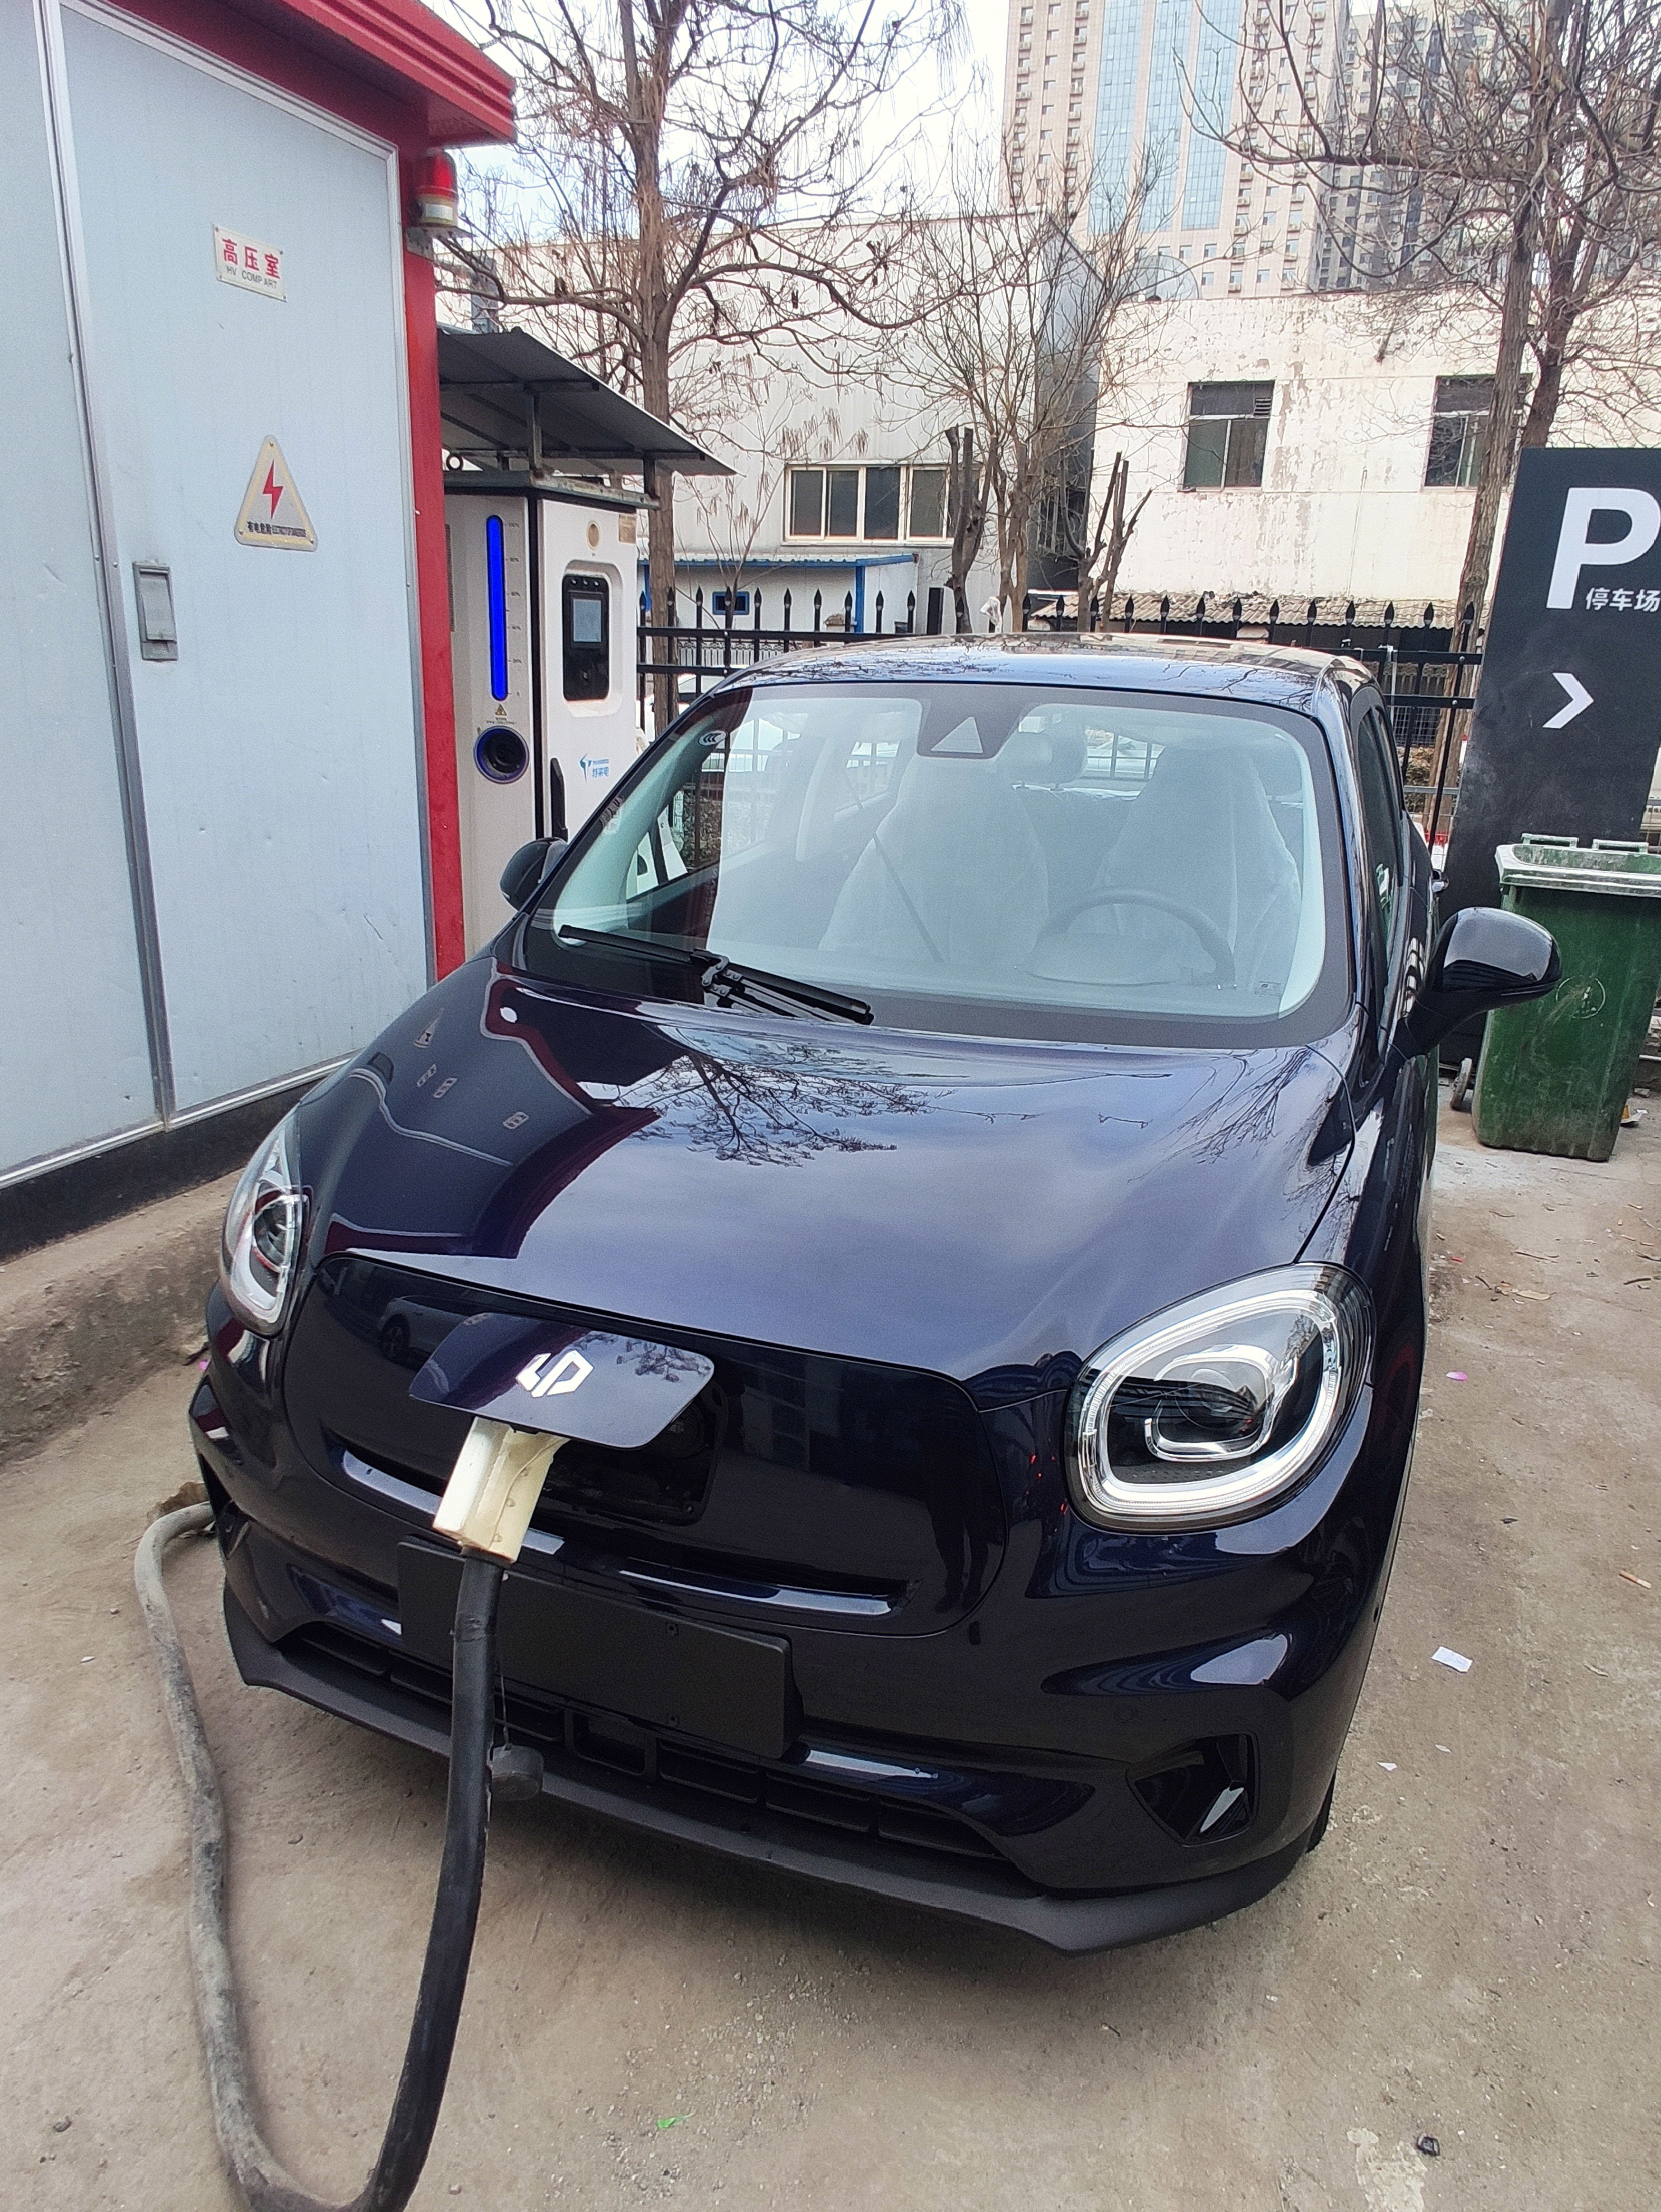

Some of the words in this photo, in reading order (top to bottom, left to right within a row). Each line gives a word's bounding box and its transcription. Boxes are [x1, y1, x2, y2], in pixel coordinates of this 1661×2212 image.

[222, 238, 280, 279] 高压室
[227, 267, 237, 276] HV
[1546, 487, 1661, 609] P
[1585, 587, 1661, 612] 停车场
